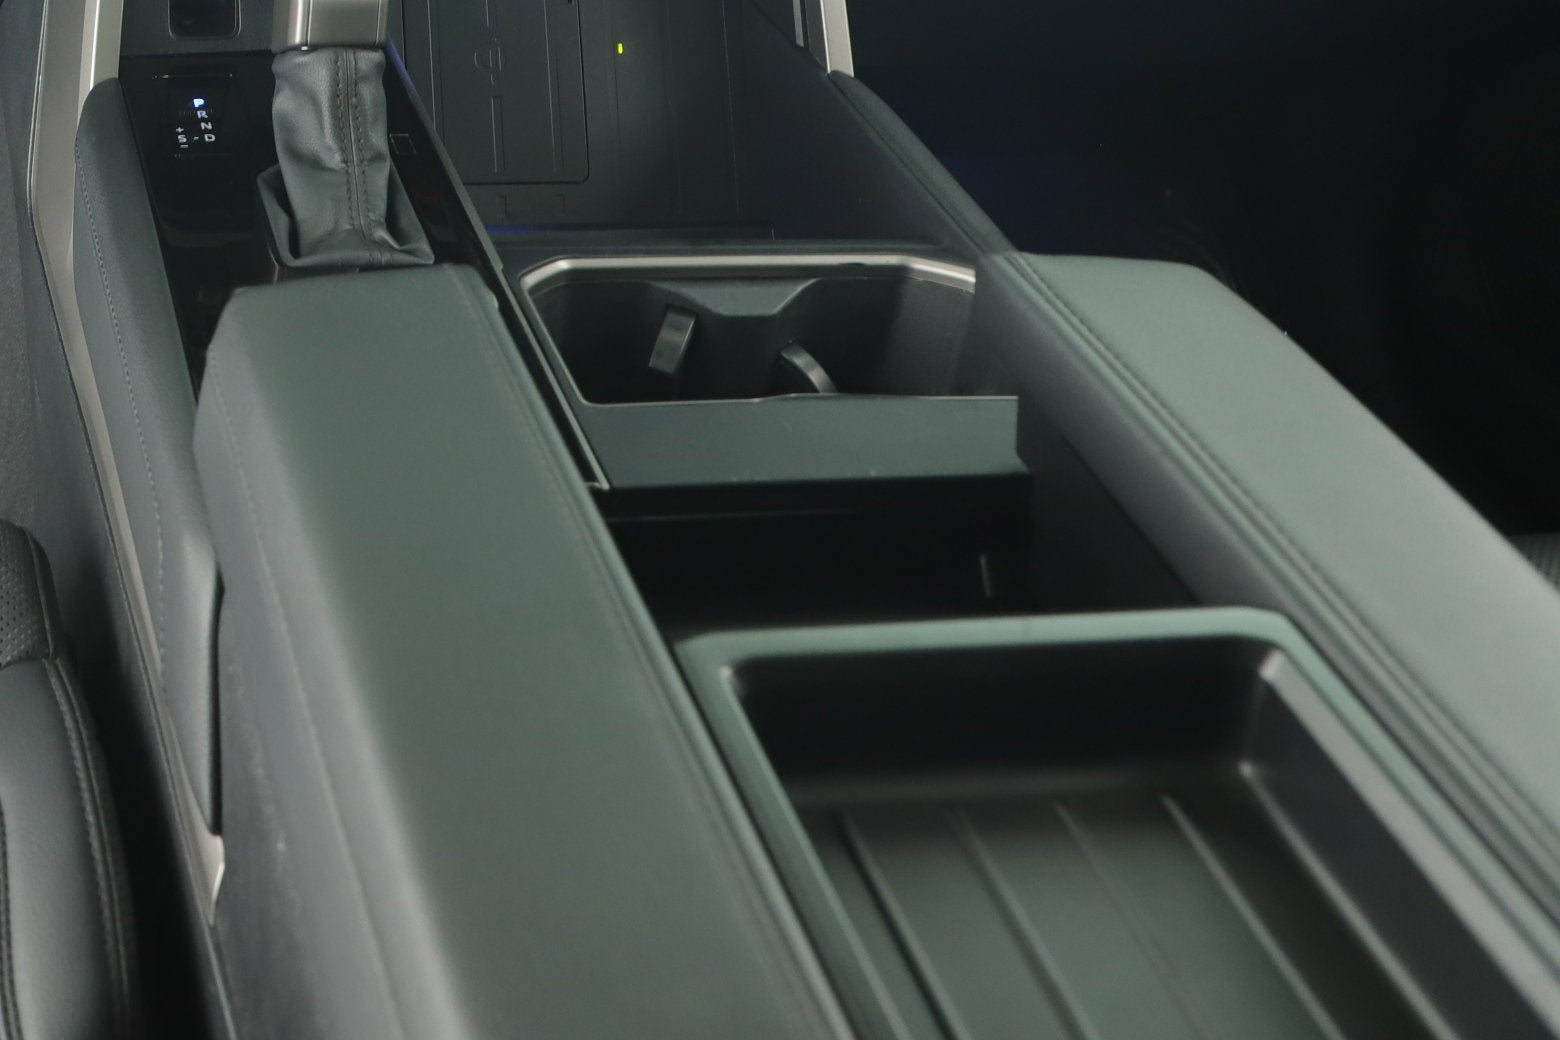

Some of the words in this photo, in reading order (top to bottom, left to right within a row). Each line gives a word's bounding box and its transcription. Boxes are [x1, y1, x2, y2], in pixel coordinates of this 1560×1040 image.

[193, 98, 205, 108] P
[196, 110, 209, 119] R
[200, 121, 213, 130] N
[177, 134, 187, 144] S
[204, 133, 216, 142] D
